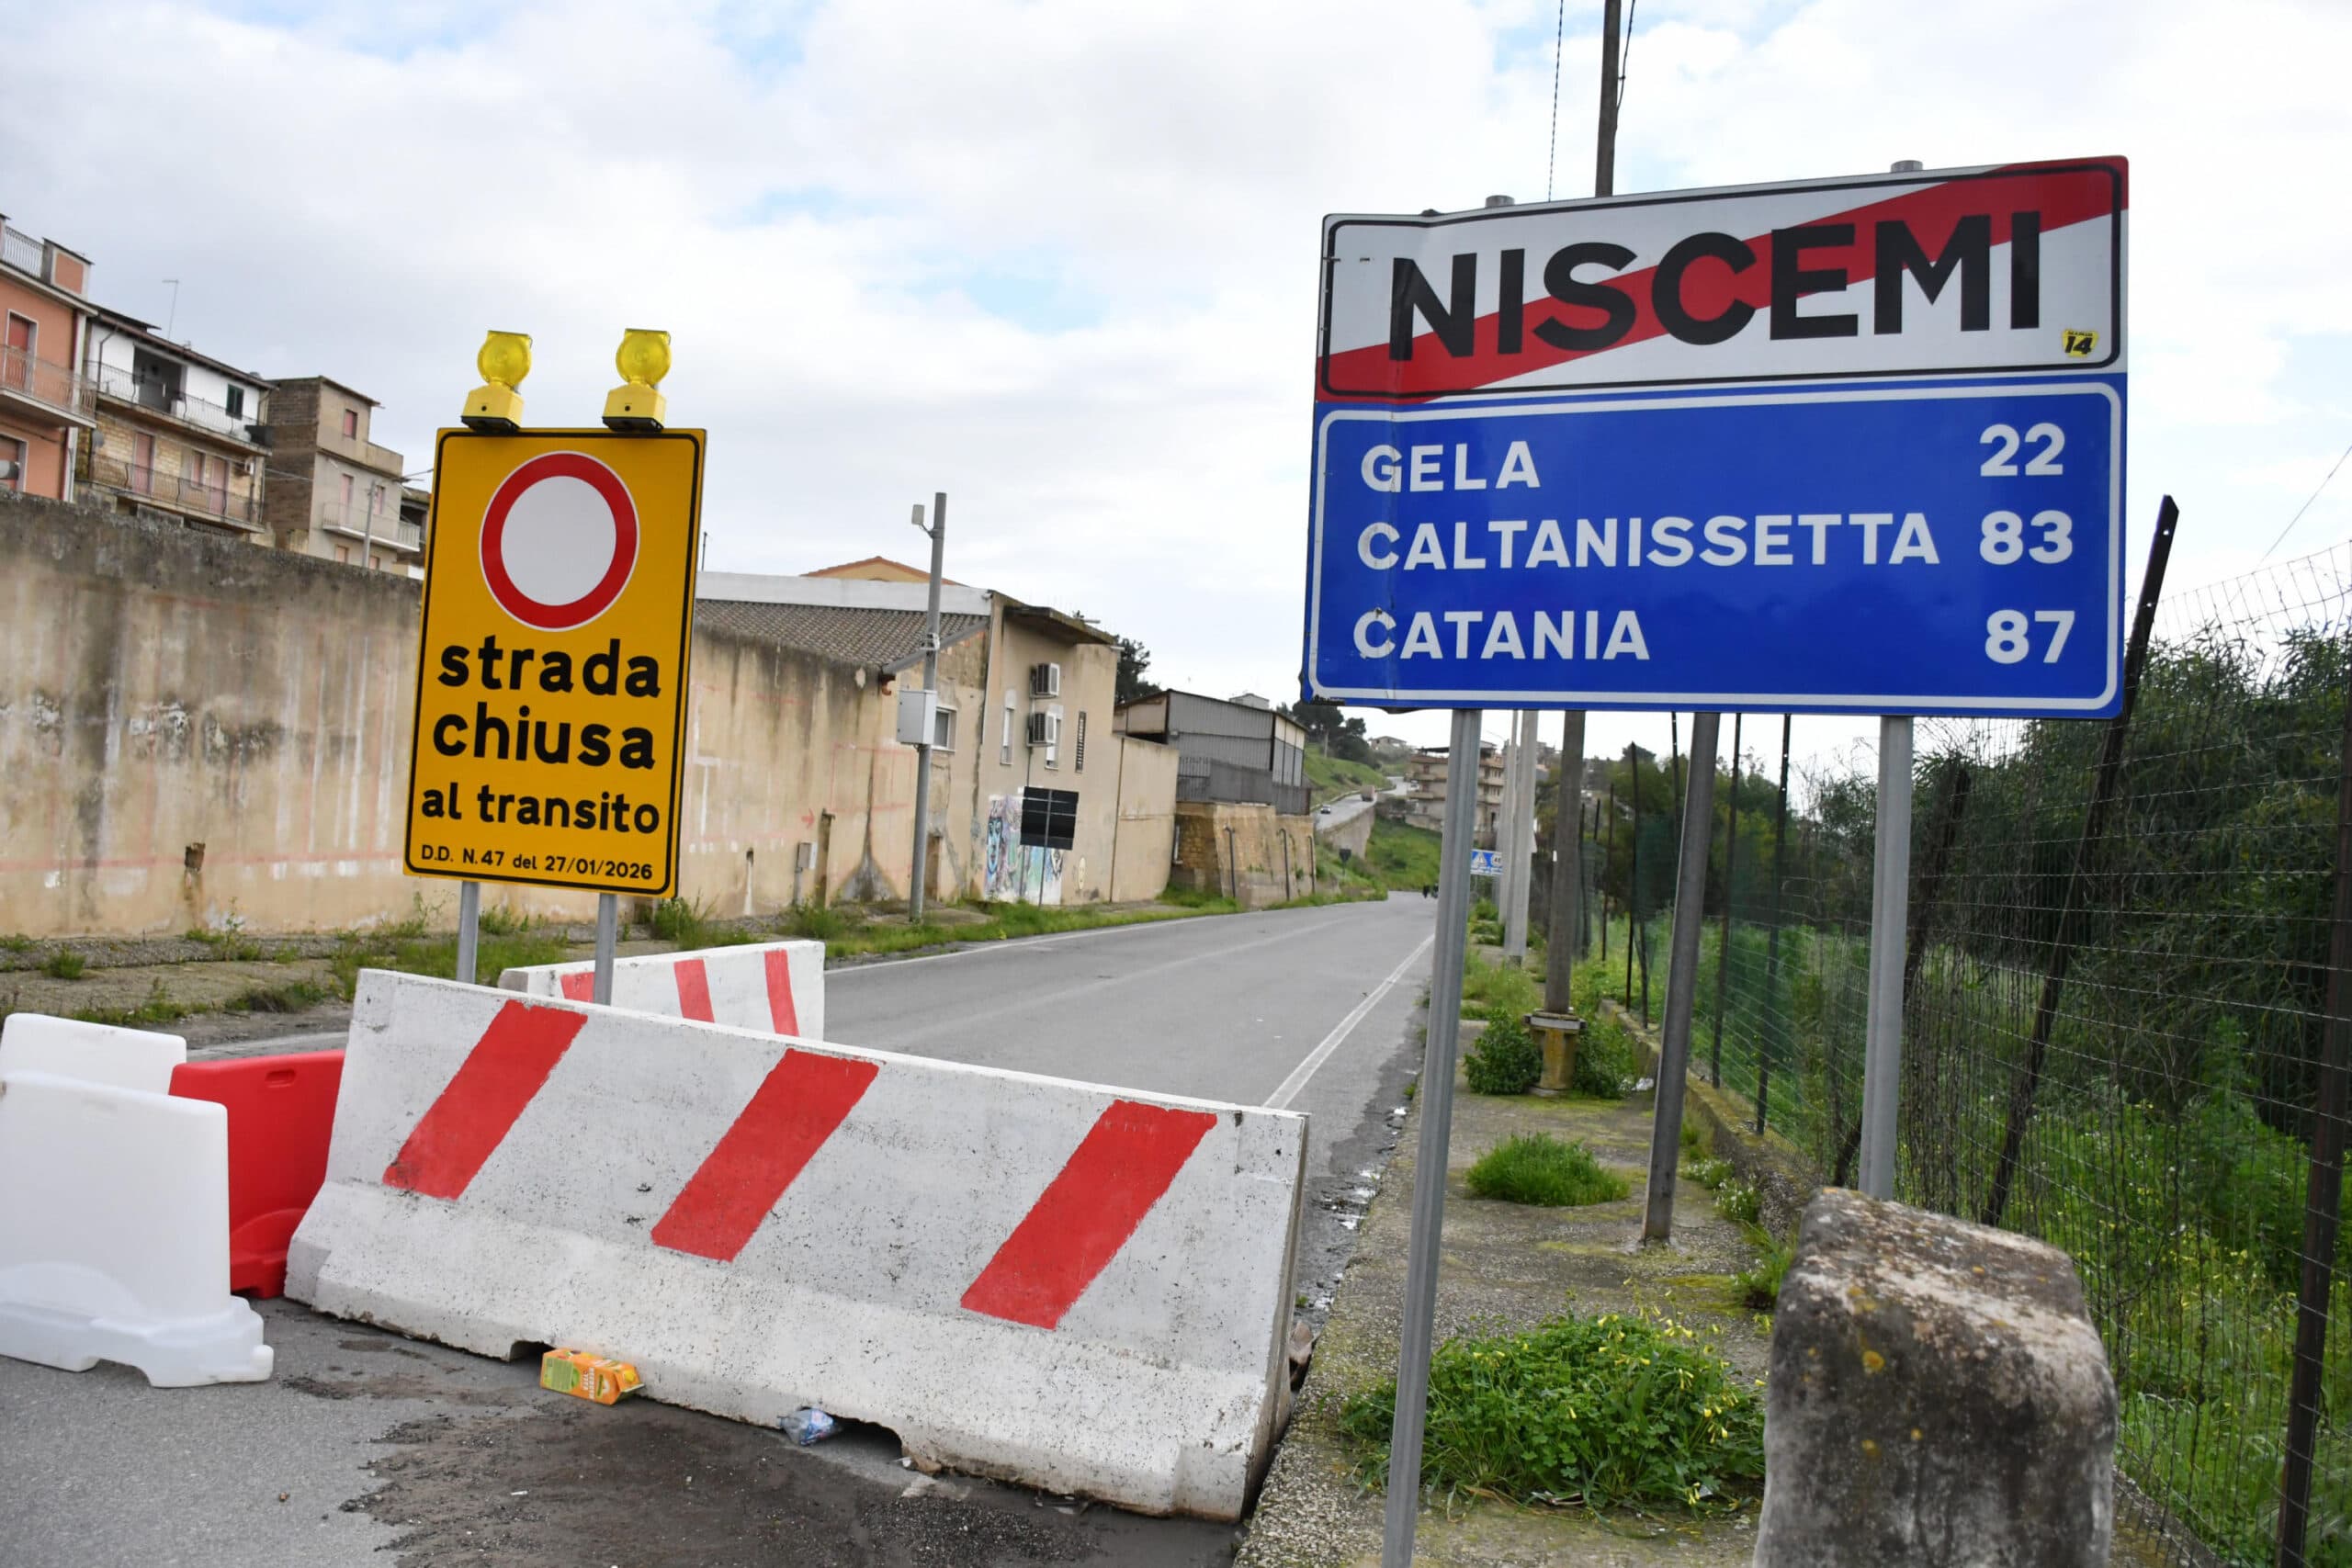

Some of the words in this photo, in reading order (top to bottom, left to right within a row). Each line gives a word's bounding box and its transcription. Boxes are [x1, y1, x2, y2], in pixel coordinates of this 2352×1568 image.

[1387, 209, 2042, 363] NISCEMI
[2065, 336, 2093, 355] 14
[1361, 440, 1542, 493] GELA
[1979, 423, 2065, 477] 22
[1357, 513, 1940, 570] CALTANISSETTA
[1979, 510, 2073, 565] 83
[436, 634, 662, 698] strada
[1352, 608, 1650, 660] CATANIA
[1984, 609, 2075, 664] 87
[432, 701, 657, 770] chiusa
[420, 782, 462, 820] al
[477, 784, 661, 835] transito
[421, 844, 455, 863] D.D.
[512, 853, 537, 870] del
[545, 855, 653, 880] 27/01/2026
